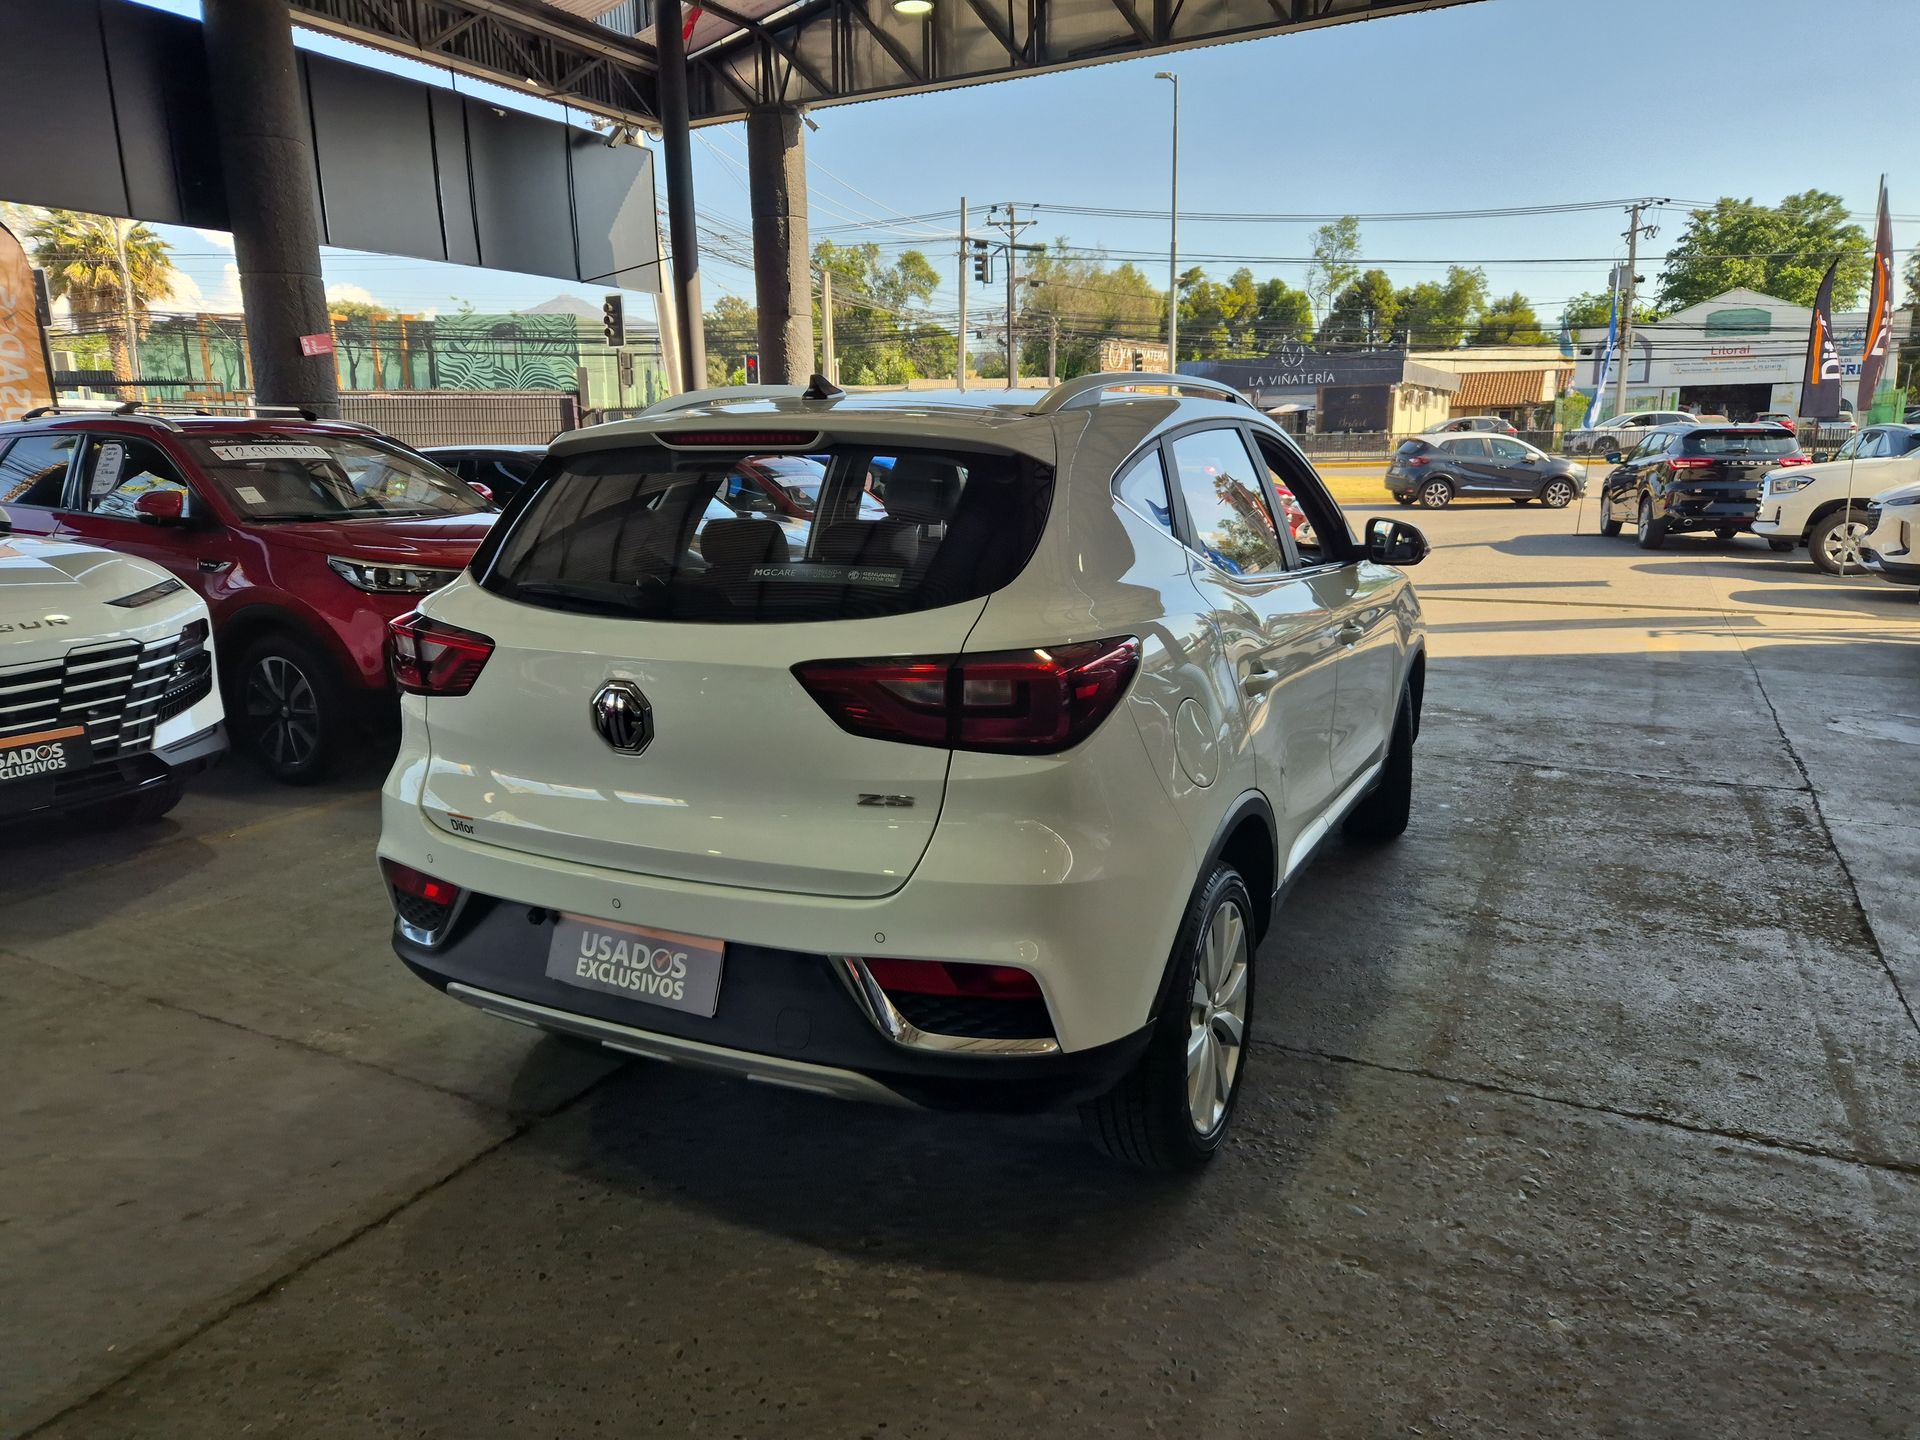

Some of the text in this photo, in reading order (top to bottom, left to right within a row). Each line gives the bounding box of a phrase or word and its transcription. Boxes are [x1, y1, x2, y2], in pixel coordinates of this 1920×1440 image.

[1711, 345, 1751, 356] Litoral
[1249, 376, 1264, 387] LA
[450, 818, 475, 835] Difor
[580, 930, 689, 979] USADOS
[575, 956, 685, 1001] EXCLUSIVOS
